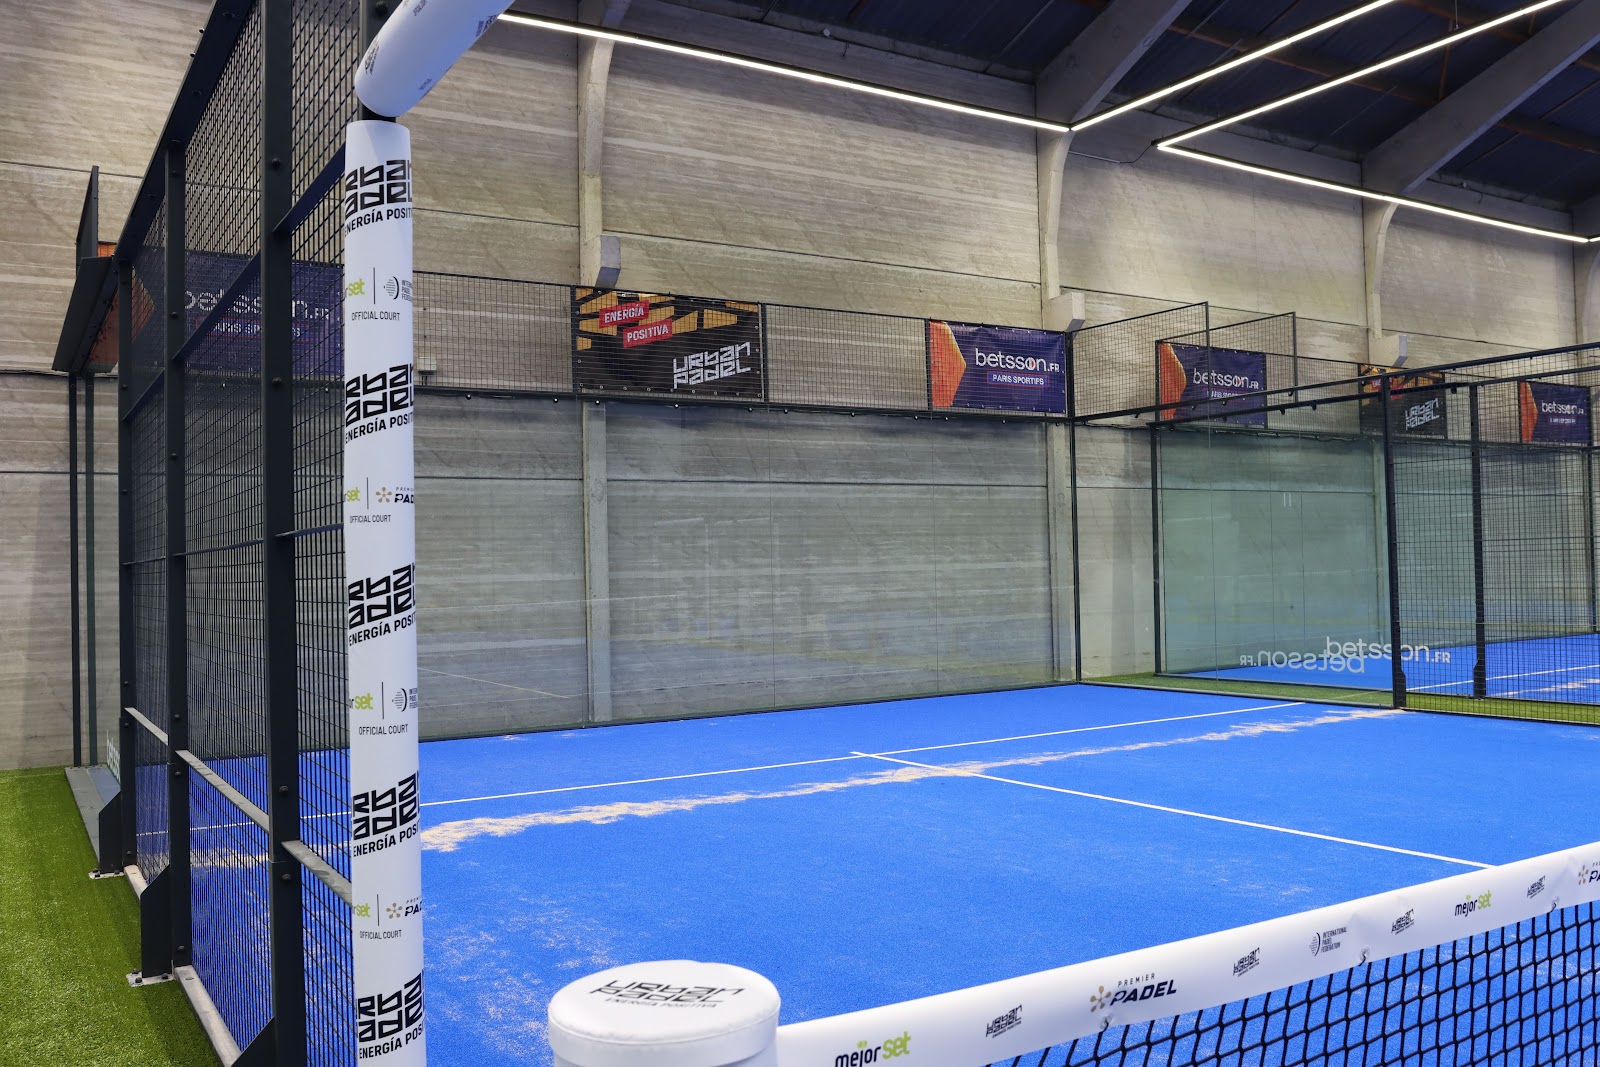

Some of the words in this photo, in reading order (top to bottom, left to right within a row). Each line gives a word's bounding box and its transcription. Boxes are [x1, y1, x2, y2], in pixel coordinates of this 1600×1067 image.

[351, 311, 378, 321] OFFICIAL
[380, 311, 401, 321] COURT
[604, 304, 645, 323] ENERGÍA
[626, 324, 669, 343] POSITIVA
[975, 348, 1060, 373] betsson.FR
[992, 374, 1012, 383] PARIS
[1013, 376, 1045, 386] SPORTIFS
[350, 515, 371, 523] OFFICIAL
[372, 514, 391, 523] COURT
[358, 725, 387, 736] OFFICIAL
[388, 723, 409, 735] COURT
[360, 930, 382, 940] OFFICIAL
[382, 929, 402, 939] COURT
[1117, 972, 1156, 988] PREMIER
[1110, 979, 1177, 1006] PADEL
